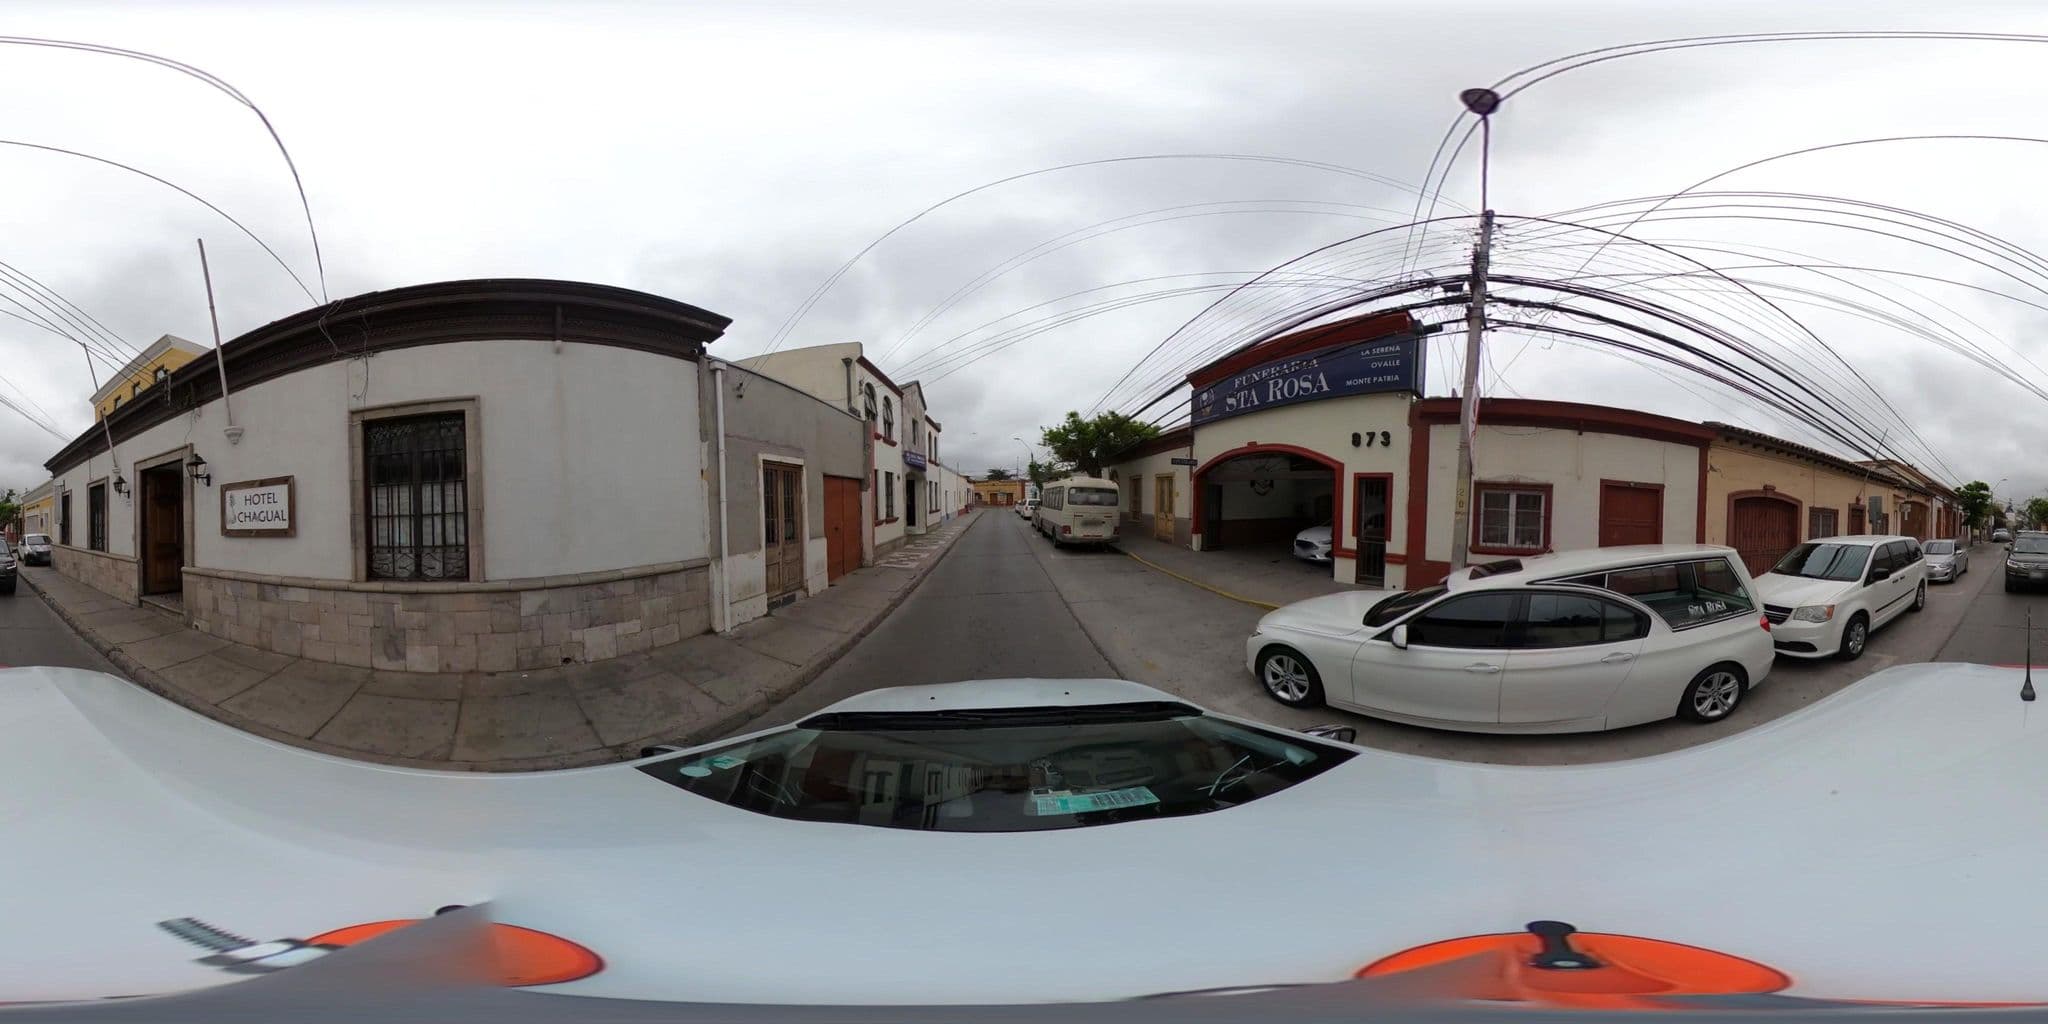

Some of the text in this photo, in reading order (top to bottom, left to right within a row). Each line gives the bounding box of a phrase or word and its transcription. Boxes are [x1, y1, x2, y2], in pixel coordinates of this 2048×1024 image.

[1372, 345, 1400, 354] SERENA
[1371, 360, 1400, 368] OVALLE
[1234, 358, 1320, 388] FUNERARIA
[1345, 375, 1400, 386] MONTE PATRIA
[1225, 371, 1331, 412] STA ROSA
[1351, 431, 1391, 448] 873
[244, 492, 278, 506] HOTEL
[237, 510, 287, 523] CHAGUAL
[1705, 601, 1727, 613] ROSA
